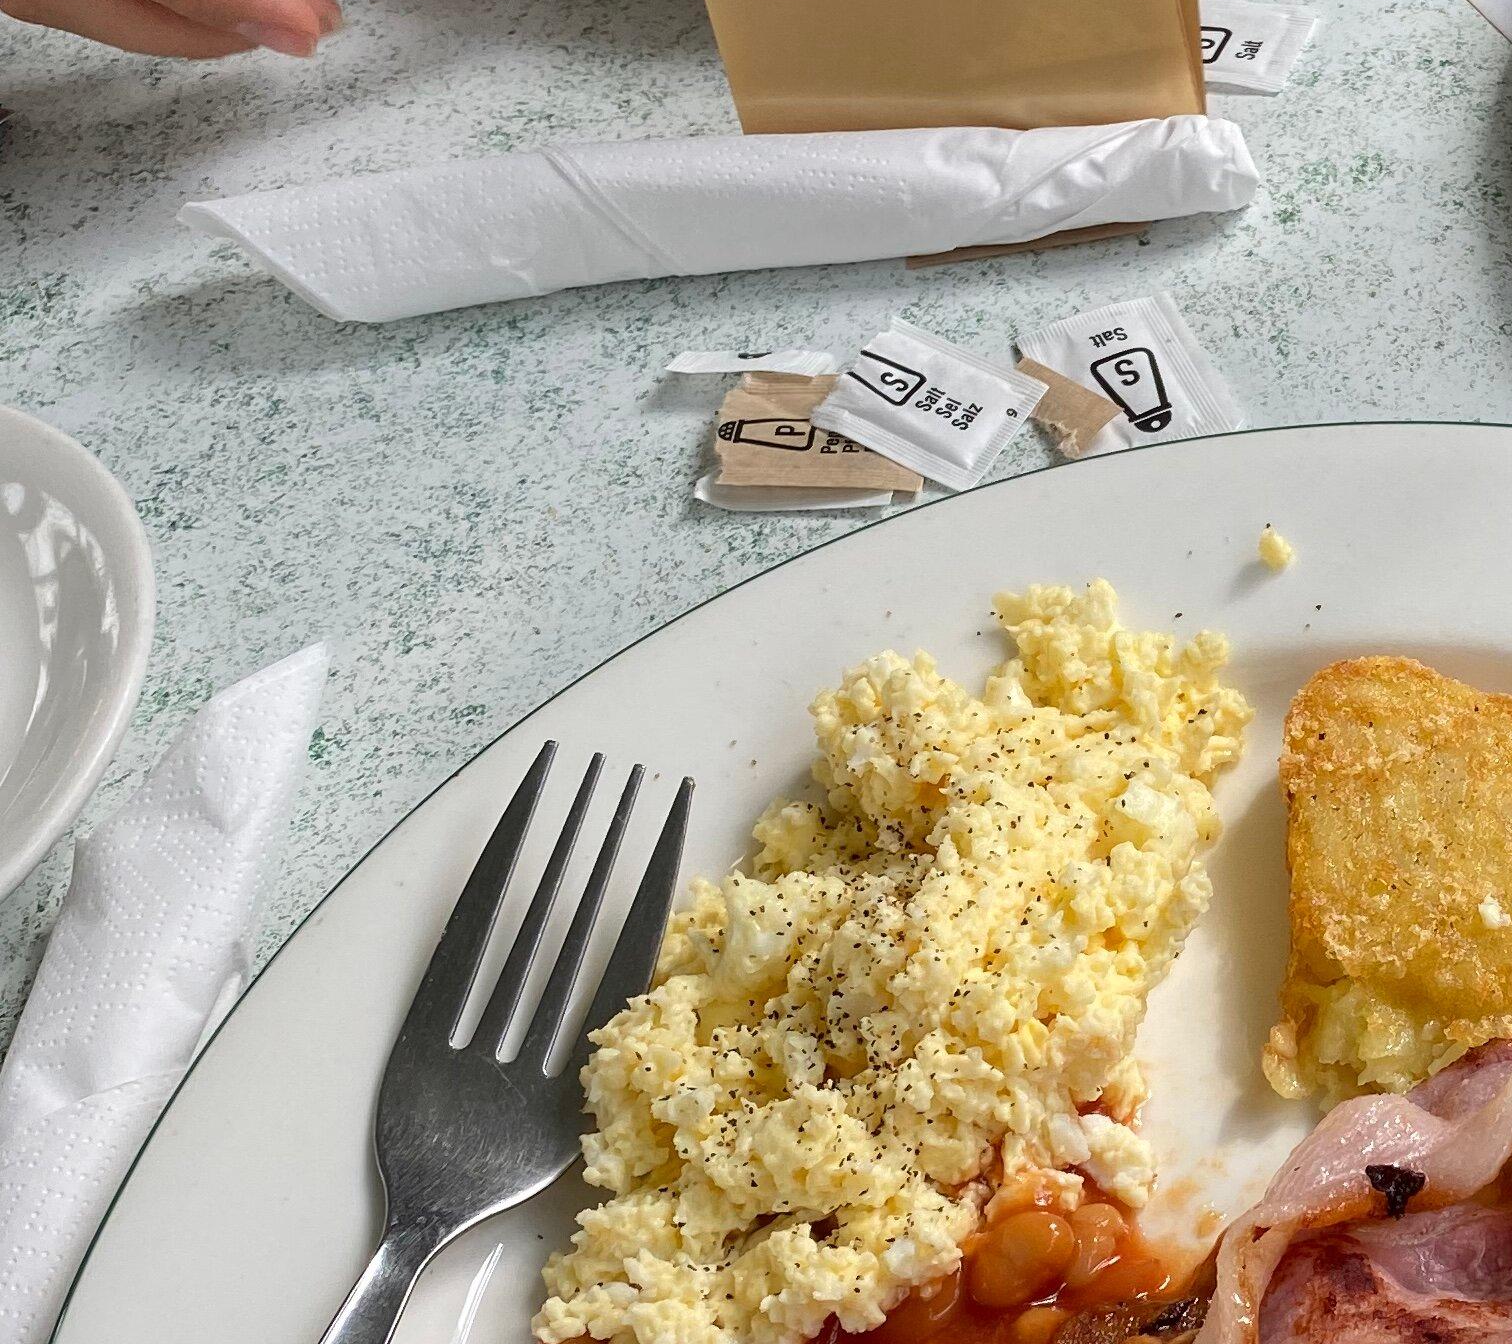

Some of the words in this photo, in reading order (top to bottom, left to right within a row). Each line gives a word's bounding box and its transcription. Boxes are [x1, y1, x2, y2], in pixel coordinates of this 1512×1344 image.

[1235, 39, 1263, 60] Salt
[1088, 327, 1128, 348] Salt
[880, 372, 909, 392] S
[1114, 359, 1140, 386] S
[915, 387, 946, 412] Salt
[935, 397, 962, 419] Sel
[951, 403, 984, 431] Salz
[775, 425, 806, 436] P
